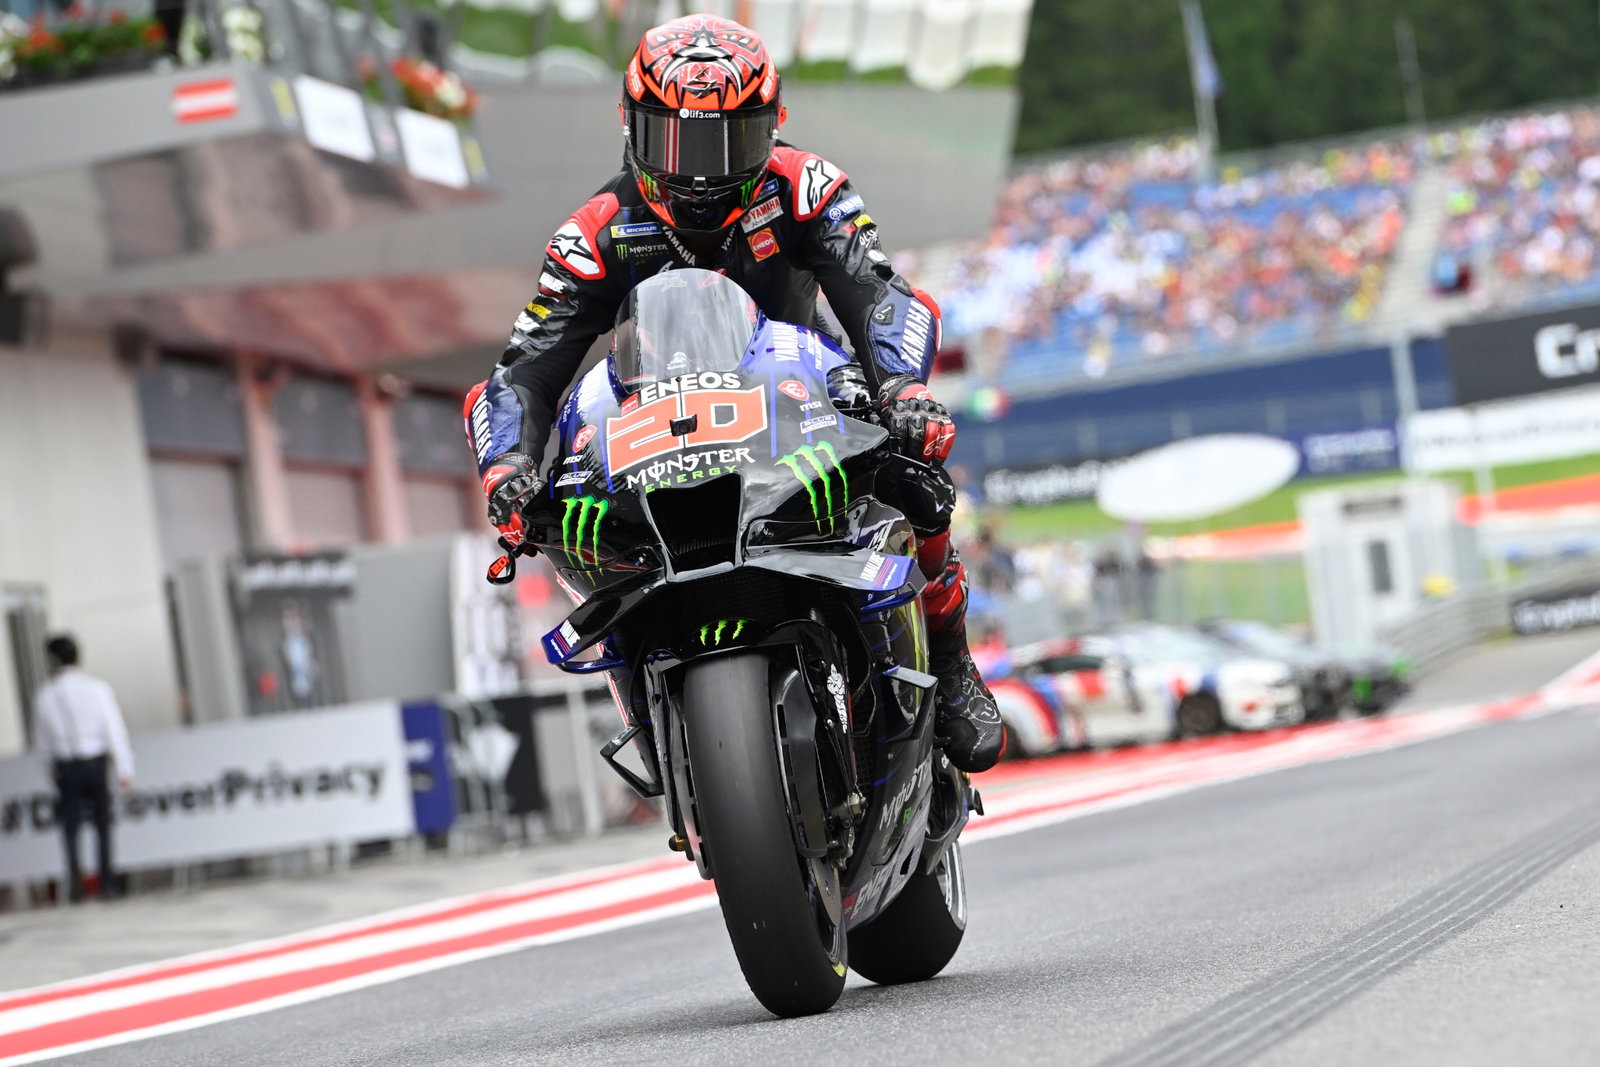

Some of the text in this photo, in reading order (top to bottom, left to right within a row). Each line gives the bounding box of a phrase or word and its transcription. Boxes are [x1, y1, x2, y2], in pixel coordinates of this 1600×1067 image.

[689, 109, 721, 119] lif3.com
[750, 198, 780, 219] YAMAHA
[752, 237, 774, 252] ENEOS
[901, 299, 932, 370] YAMAHA
[640, 371, 741, 404] ENEOS
[606, 384, 768, 477] 20
[626, 448, 756, 489] MONSTER
[644, 465, 737, 494] ENERGY
